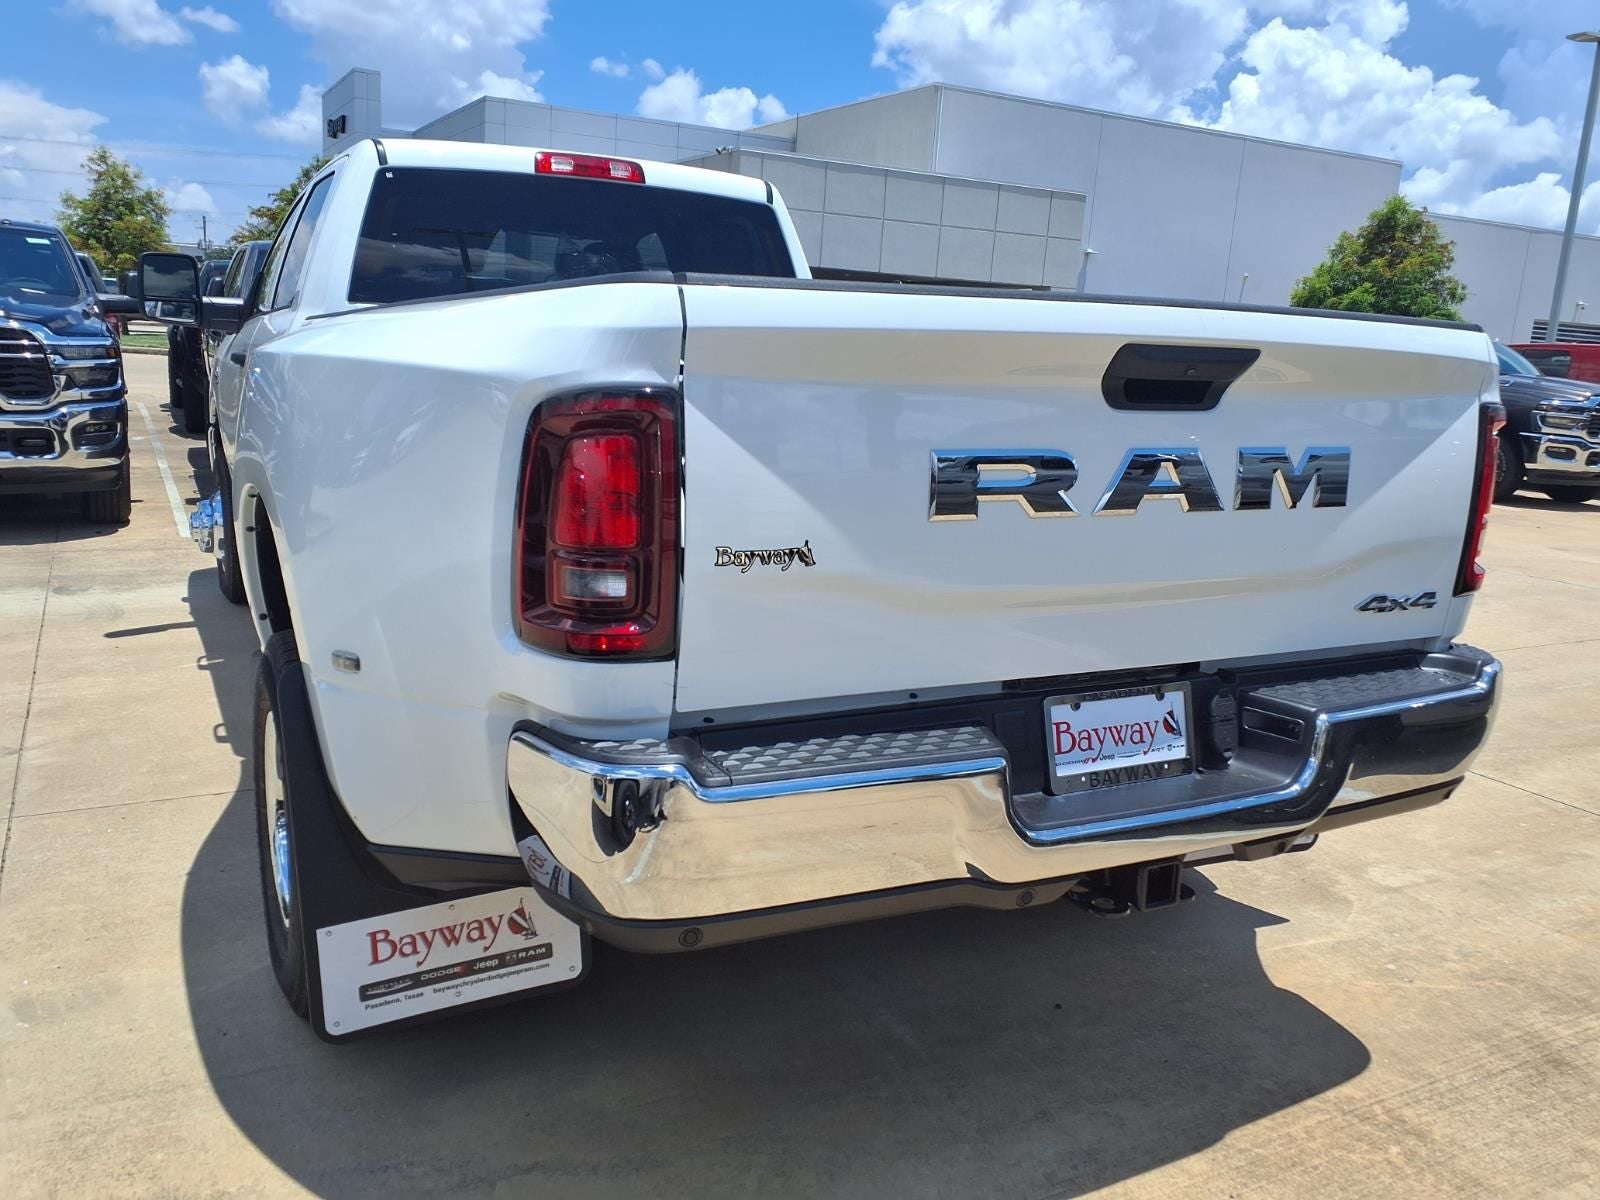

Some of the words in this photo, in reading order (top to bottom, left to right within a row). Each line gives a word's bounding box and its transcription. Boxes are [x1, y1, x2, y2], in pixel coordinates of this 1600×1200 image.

[928, 446, 1352, 522] RAM
[714, 546, 801, 574] Bayway
[1053, 720, 1159, 763] Bayway
[1099, 753, 1115, 761] Jeep
[1089, 763, 1163, 788] BAYWAY
[367, 913, 505, 968] Bayway
[420, 965, 462, 981] DODGE
[473, 958, 499, 970] Jeep
[518, 947, 546, 958] RAM
[404, 991, 424, 1001] Texas
